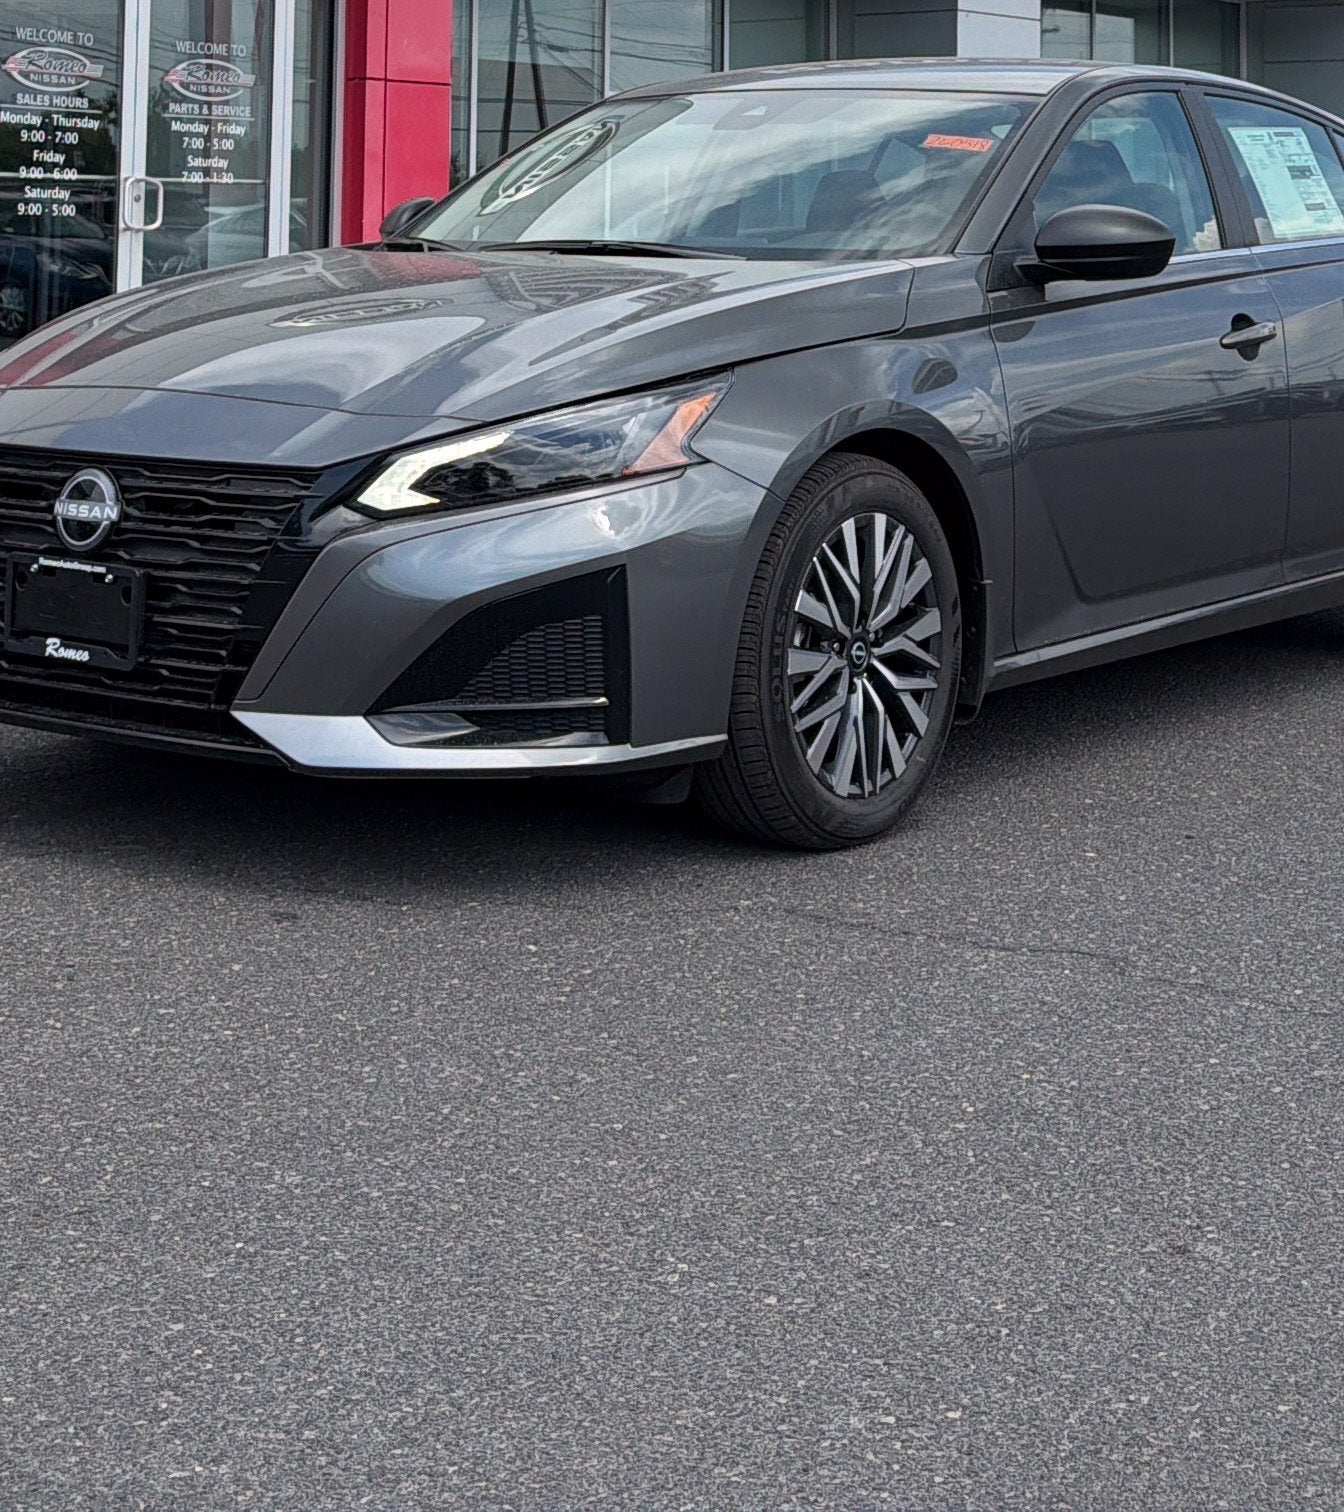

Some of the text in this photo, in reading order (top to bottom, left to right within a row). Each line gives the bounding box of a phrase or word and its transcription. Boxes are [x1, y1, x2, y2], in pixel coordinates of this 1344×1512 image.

[16, 26, 94, 46] WELCOME TO
[175, 40, 247, 57] WELCOME TO
[24, 49, 88, 73] Romeo
[29, 73, 76, 85] NISSAN
[185, 61, 241, 84] Romeo
[189, 84, 231, 94] NISSAN
[16, 92, 89, 109] SALES HOURS
[168, 102, 251, 117] PARTS & SERVICE
[0, 110, 43, 126] Monday
[52, 113, 101, 129] Thursday
[171, 120, 209, 135] Monday
[217, 123, 246, 136] Friday
[20, 129, 46, 143] 9:00
[55, 131, 79, 145] 7:00
[182, 137, 205, 149] 7:00
[212, 138, 235, 150] 5:00
[32, 149, 66, 165] Friday
[187, 155, 229, 169] Saturday
[19, 166, 44, 179] 9:00
[24, 185, 71, 201] Saturday
[17, 202, 43, 216] 9:00
[52, 203, 77, 217] 5:00
[54, 501, 119, 521] NISSAN
[45, 637, 90, 663] Romeo
